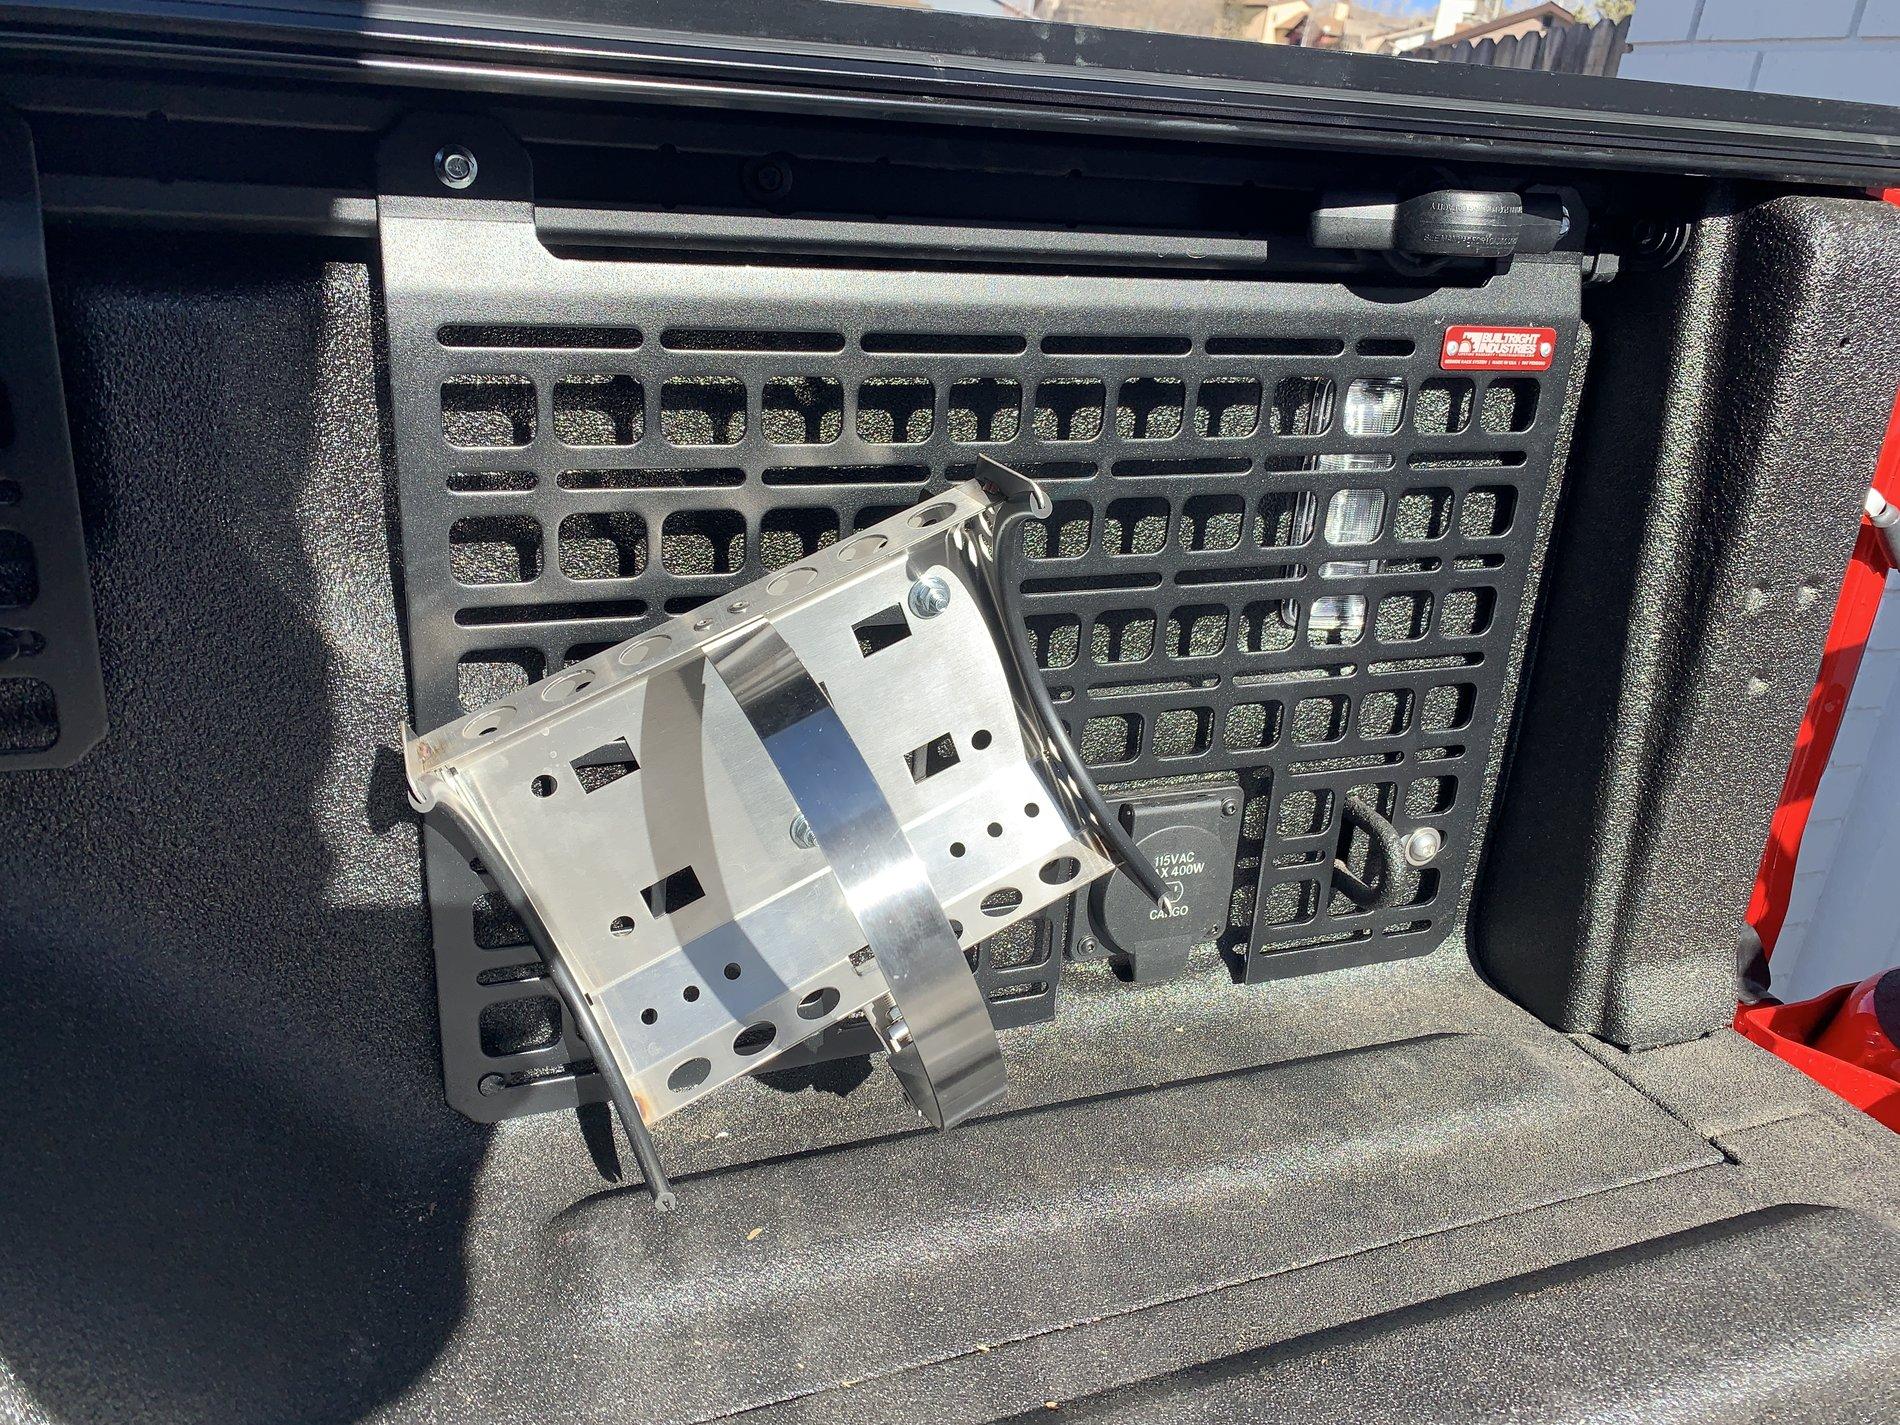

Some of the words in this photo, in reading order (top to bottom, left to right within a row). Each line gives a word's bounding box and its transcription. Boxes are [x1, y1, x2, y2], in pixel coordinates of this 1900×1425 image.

[1482, 332, 1541, 344] BUILTRIGHT
[1479, 343, 1537, 354] INDUSTRIES
[1155, 852, 1195, 866] 115VAC
[1171, 862, 1205, 876] 400W
